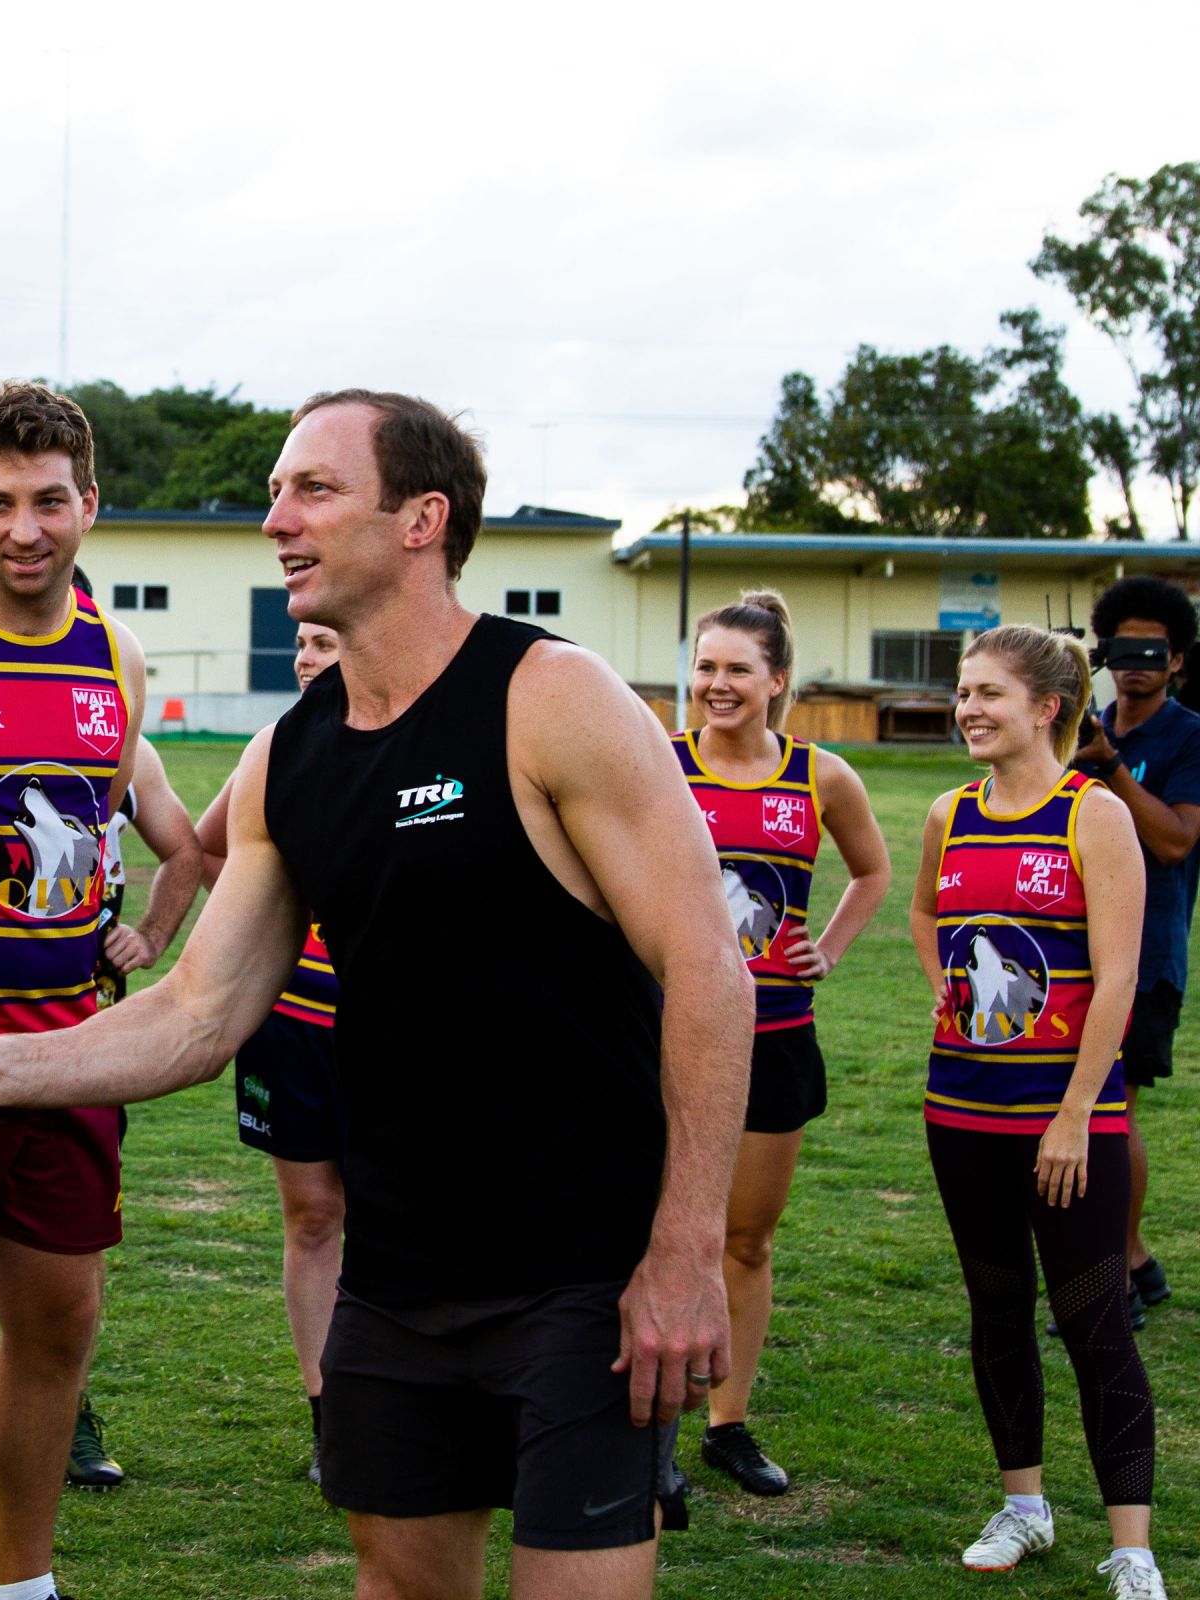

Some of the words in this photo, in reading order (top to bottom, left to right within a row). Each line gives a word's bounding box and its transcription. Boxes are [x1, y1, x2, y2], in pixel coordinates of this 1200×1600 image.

[74, 691, 116, 706] WALL
[88, 702, 105, 725] 2
[78, 720, 119, 737] WALL
[397, 781, 464, 809] TRL
[764, 798, 804, 812] WALL
[414, 816, 436, 824] Rugby
[777, 808, 792, 823] 2
[764, 820, 804, 836] WALL
[1021, 854, 1068, 870] WALL
[939, 872, 963, 891] BLK
[1033, 865, 1051, 883] 2
[1017, 879, 1065, 896] WALL
[240, 1111, 272, 1137] BLK
